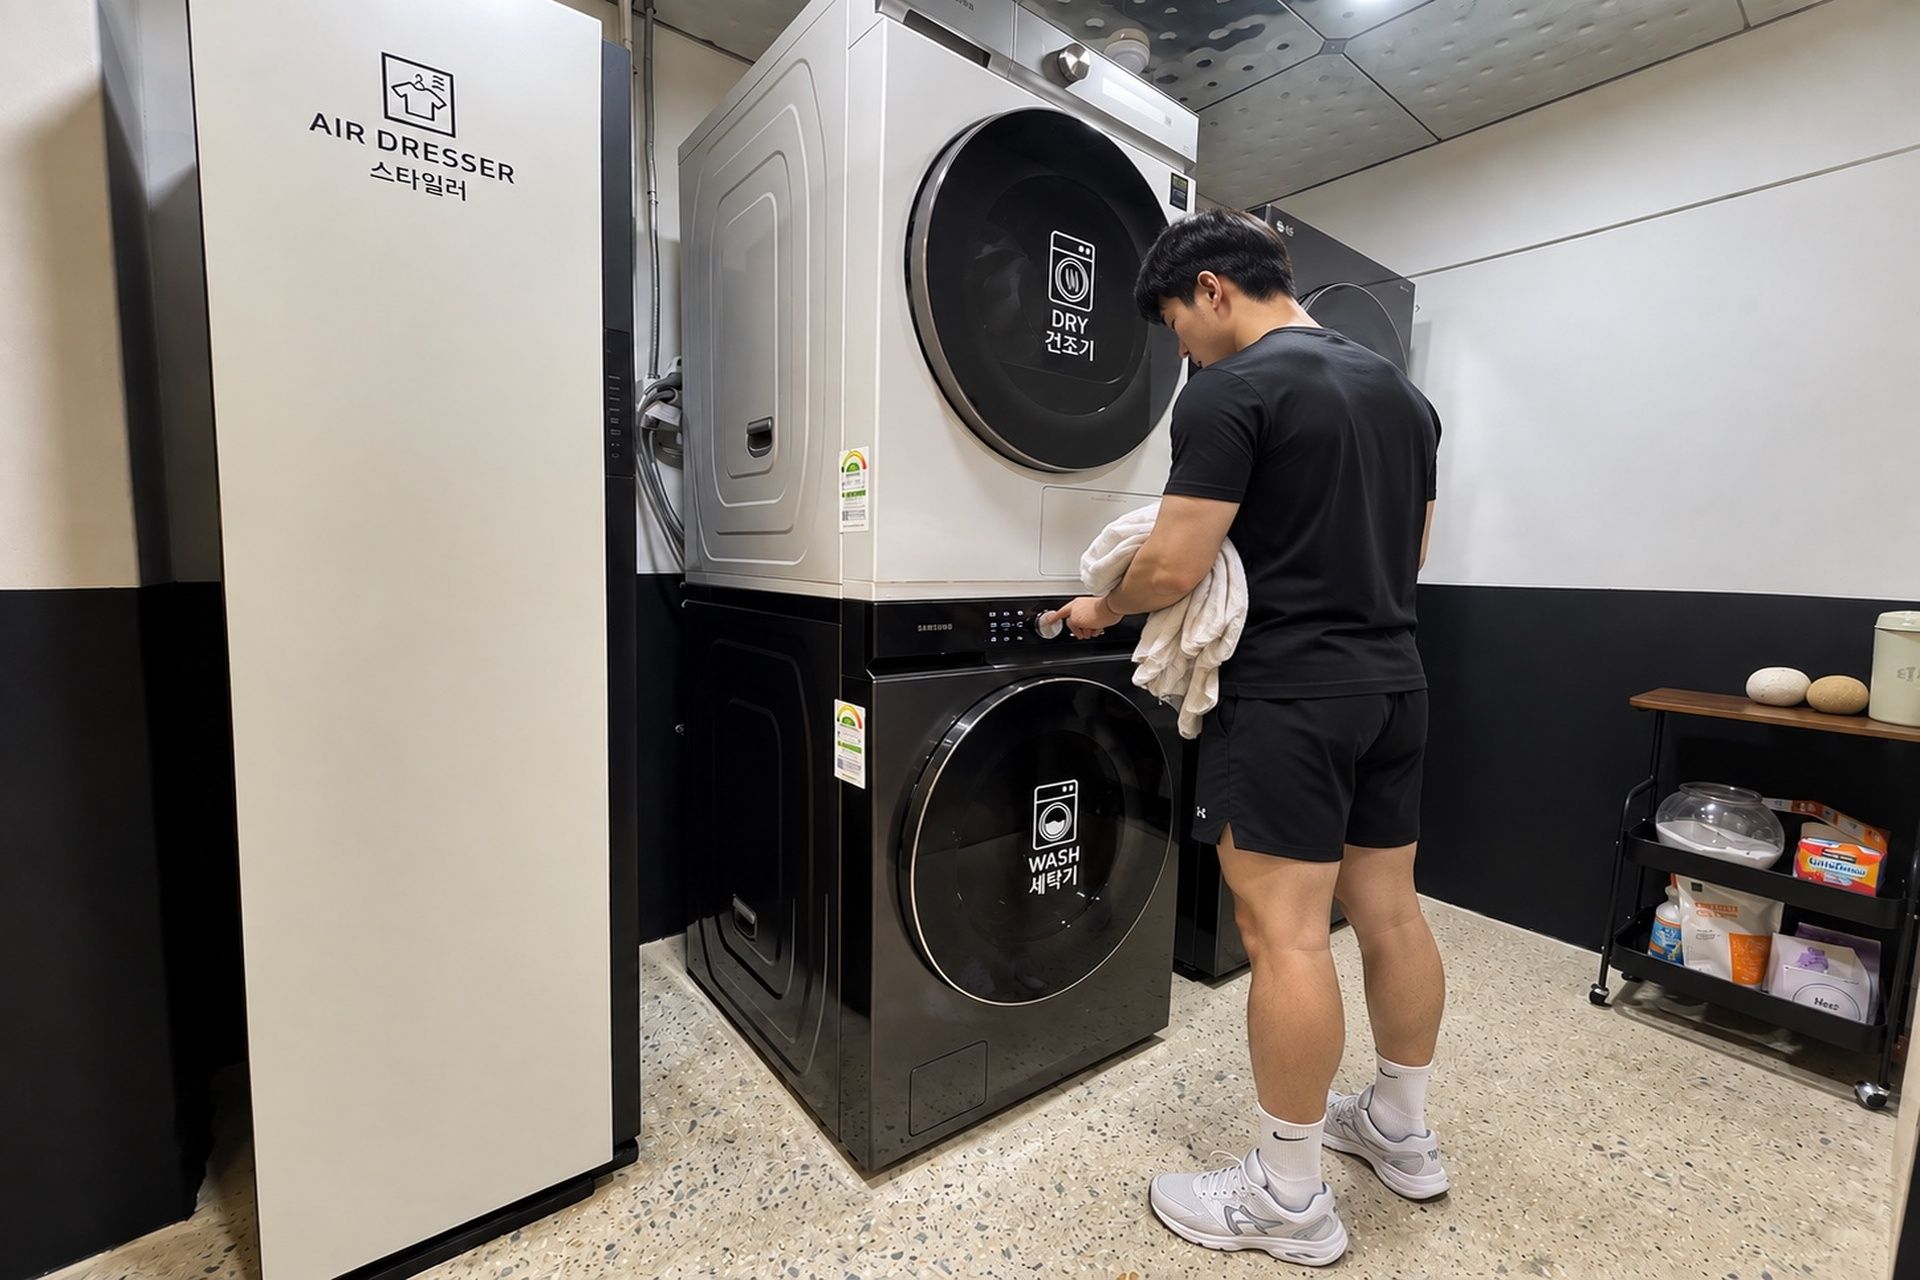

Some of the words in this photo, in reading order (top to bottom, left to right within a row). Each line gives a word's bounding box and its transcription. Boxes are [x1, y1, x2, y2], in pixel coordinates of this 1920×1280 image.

[309, 112, 366, 145] AIR
[377, 129, 516, 185] DRESSER
[370, 161, 467, 202] 스타일러
[1052, 308, 1089, 335] DRY
[1045, 330, 1094, 362] 건조기
[1028, 845, 1080, 874] WASH
[1028, 864, 1078, 895] 세탁기
